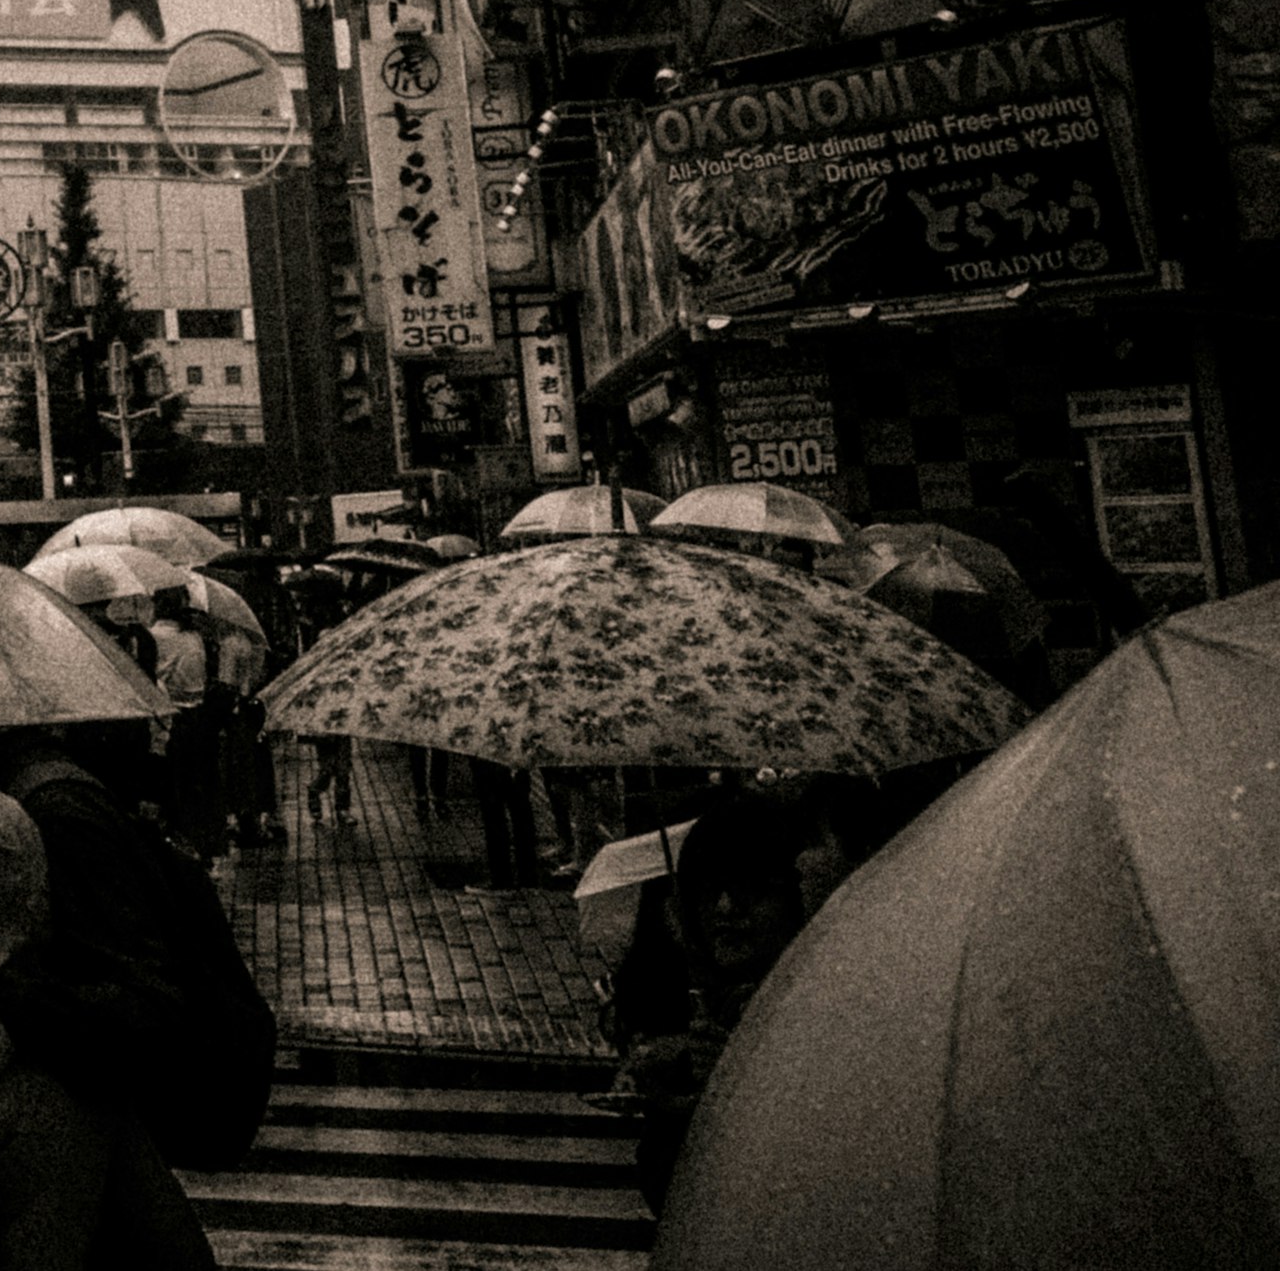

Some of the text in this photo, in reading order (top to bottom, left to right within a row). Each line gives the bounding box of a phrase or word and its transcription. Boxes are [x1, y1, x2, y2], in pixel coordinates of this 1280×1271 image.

[654, 32, 1081, 153] OKONOMI YAKI
[667, 93, 1094, 184] All-You-Can-Eat dinner with Free-Flowing
[824, 118, 1101, 184] Drinks for 2 hours ¥2,500
[943, 246, 1065, 283] TORADYU
[401, 303, 478, 322] かけそば
